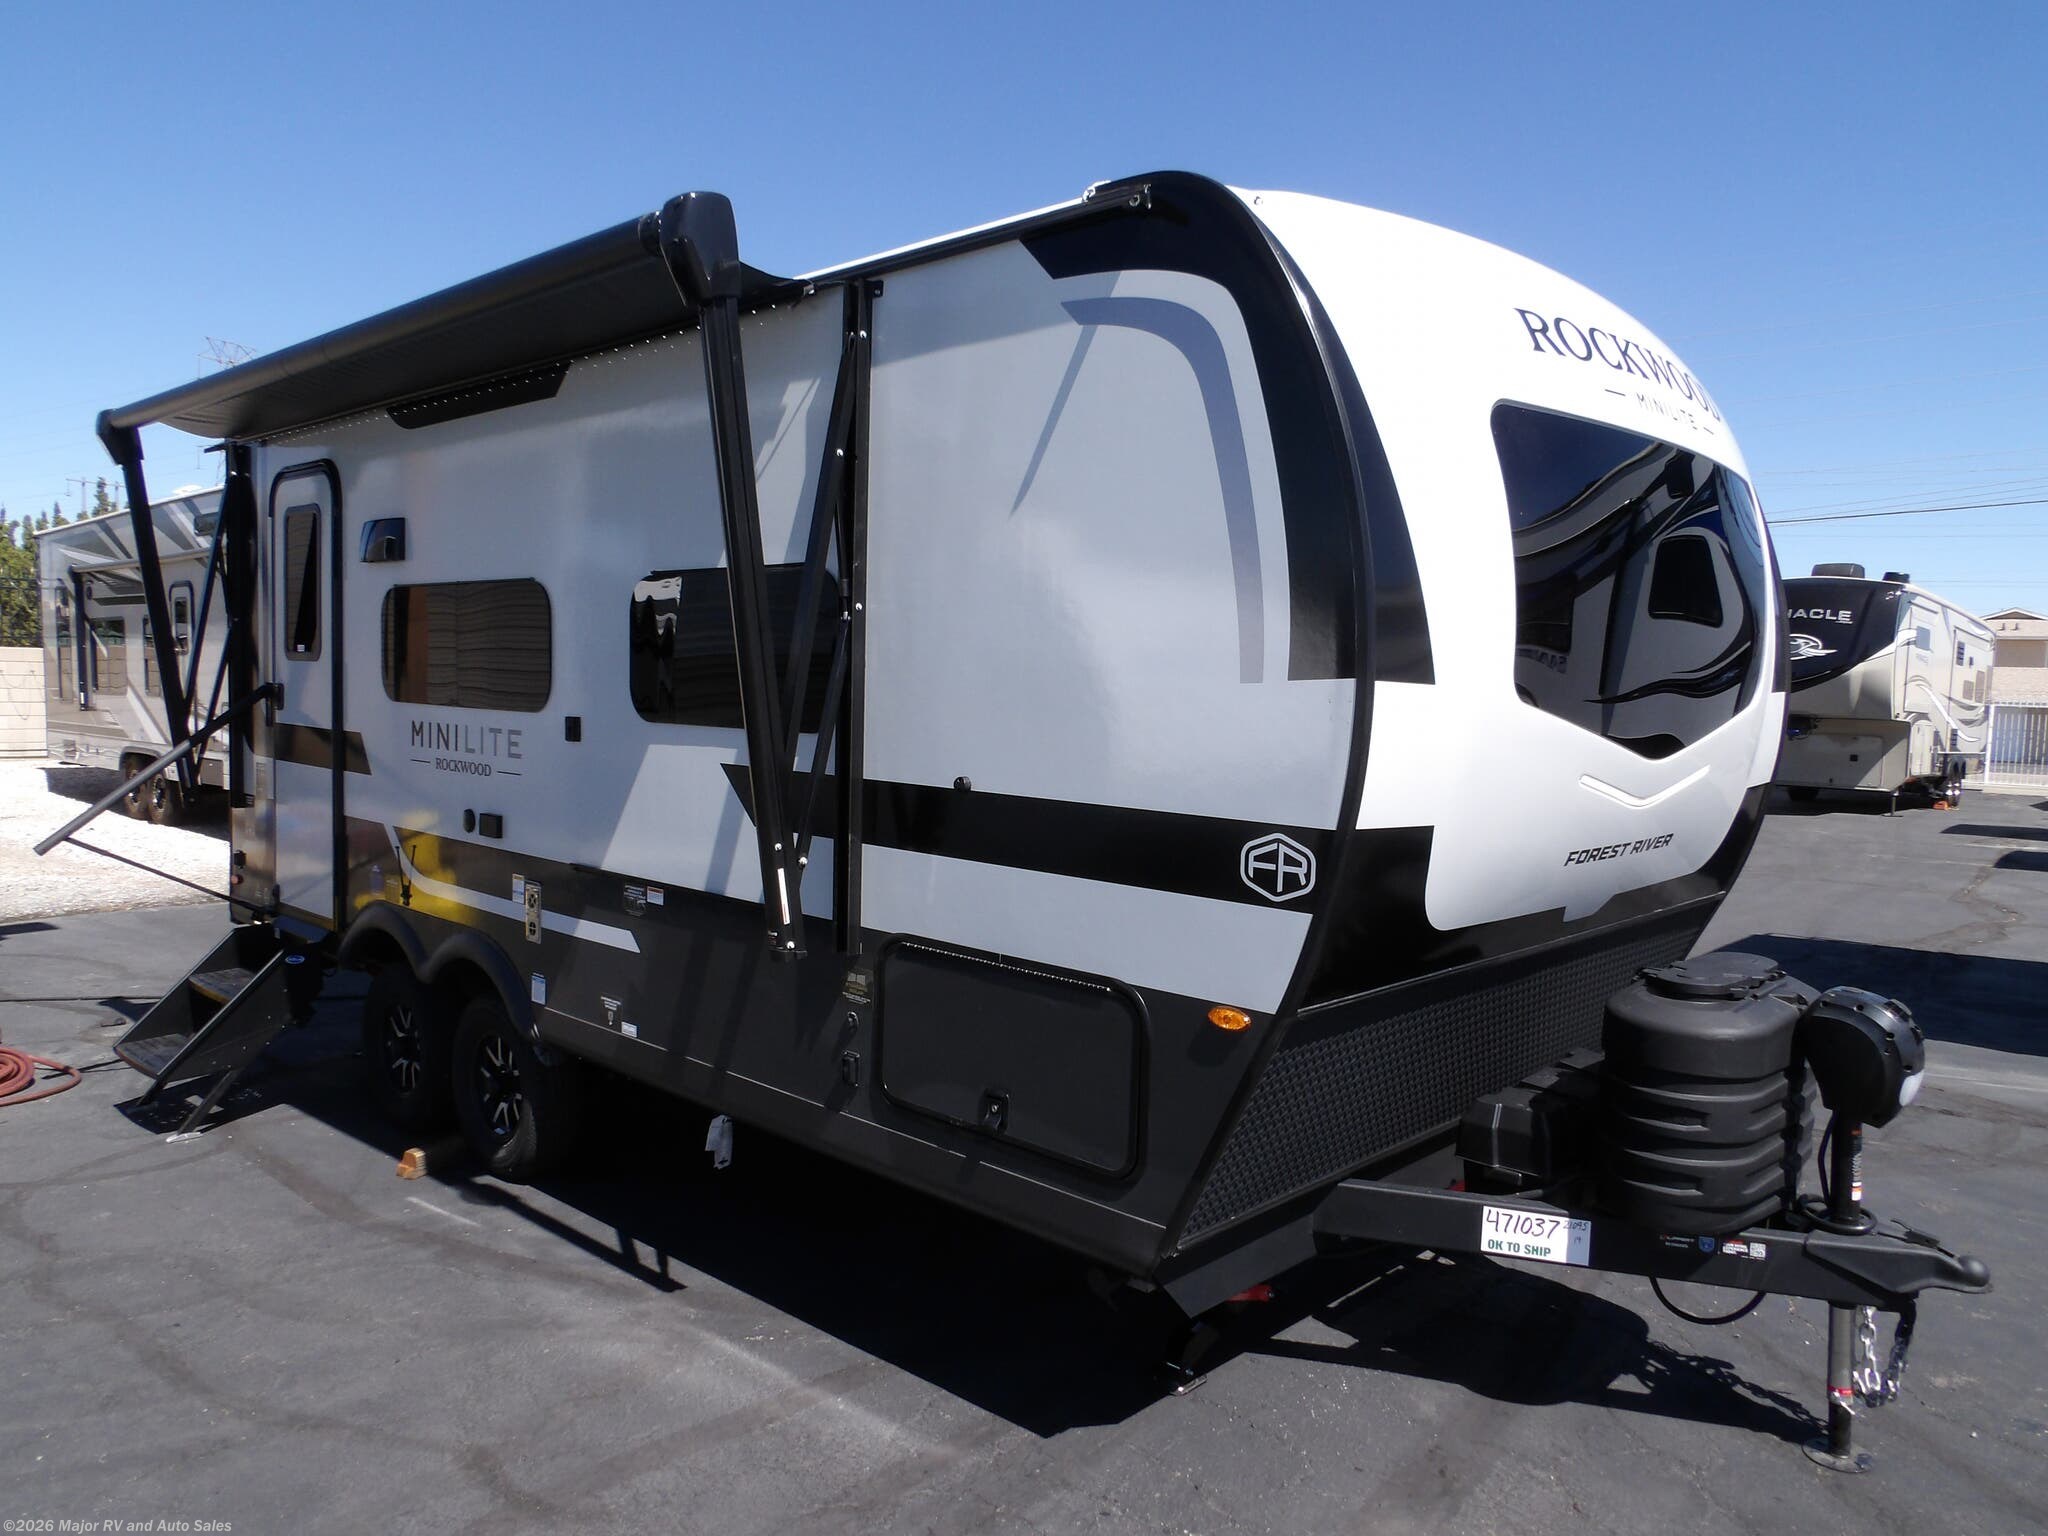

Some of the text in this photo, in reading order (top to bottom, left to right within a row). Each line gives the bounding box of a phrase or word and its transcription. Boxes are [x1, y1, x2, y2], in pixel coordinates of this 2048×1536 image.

[411, 719, 522, 759] MINILITE
[435, 757, 492, 777] ROCKWOOD
[1563, 833, 1674, 867] FOREST RIVER
[1248, 842, 1308, 893] FR
[1486, 1209, 1560, 1239] 471037
[1487, 1238, 1552, 1257] OK TO SHIP
